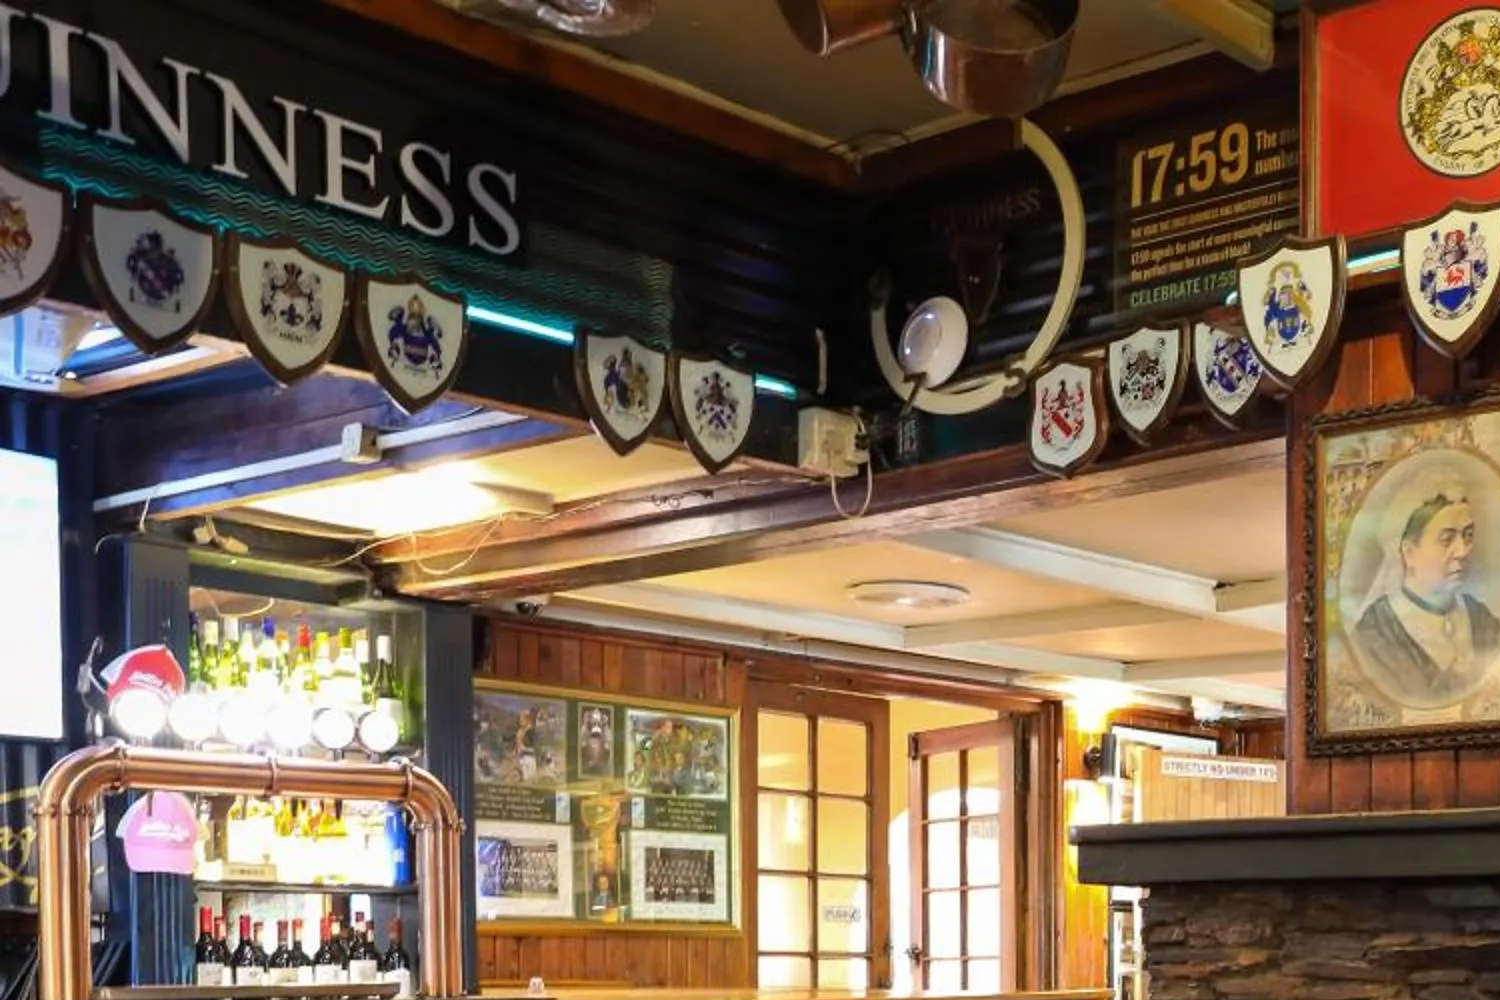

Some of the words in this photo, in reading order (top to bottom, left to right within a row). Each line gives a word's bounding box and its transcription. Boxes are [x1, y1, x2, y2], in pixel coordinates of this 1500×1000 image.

[1255, 129, 1277, 150] The
[1131, 122, 1249, 209] 17:59
[1131, 279, 1200, 308] CELEBRATE
